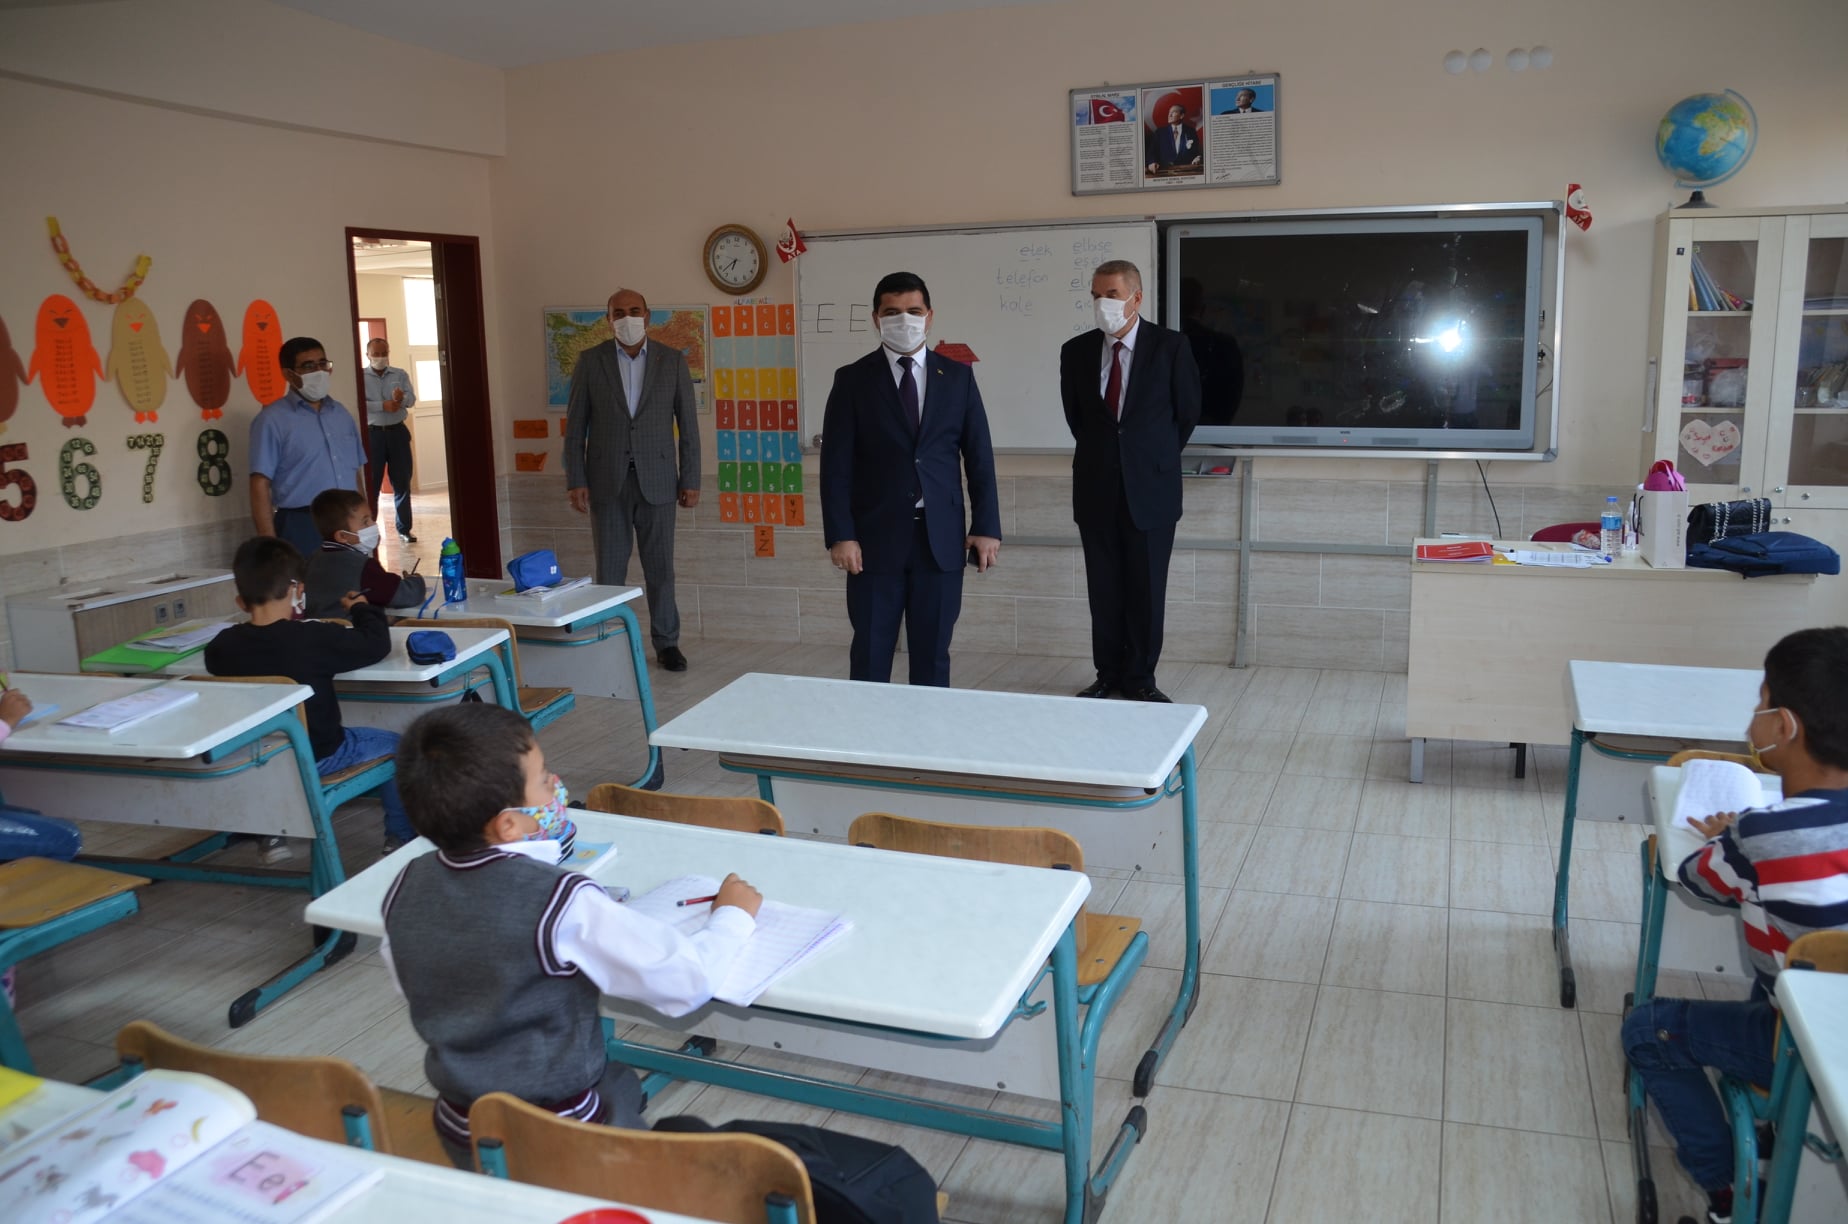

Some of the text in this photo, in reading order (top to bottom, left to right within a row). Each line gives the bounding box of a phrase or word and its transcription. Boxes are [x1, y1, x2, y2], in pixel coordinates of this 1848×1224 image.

[787, 249, 801, 260] ATA
[996, 267, 1049, 288] telefon
[1000, 293, 1032, 311] kale
[817, 303, 869, 333] E E
[0, 442, 38, 521] 5
[59, 437, 102, 511] 6
[126, 433, 164, 503] 7
[197, 429, 232, 496] 8
[758, 539, 769, 551] Z
[229, 1151, 286, 1192] Ee
